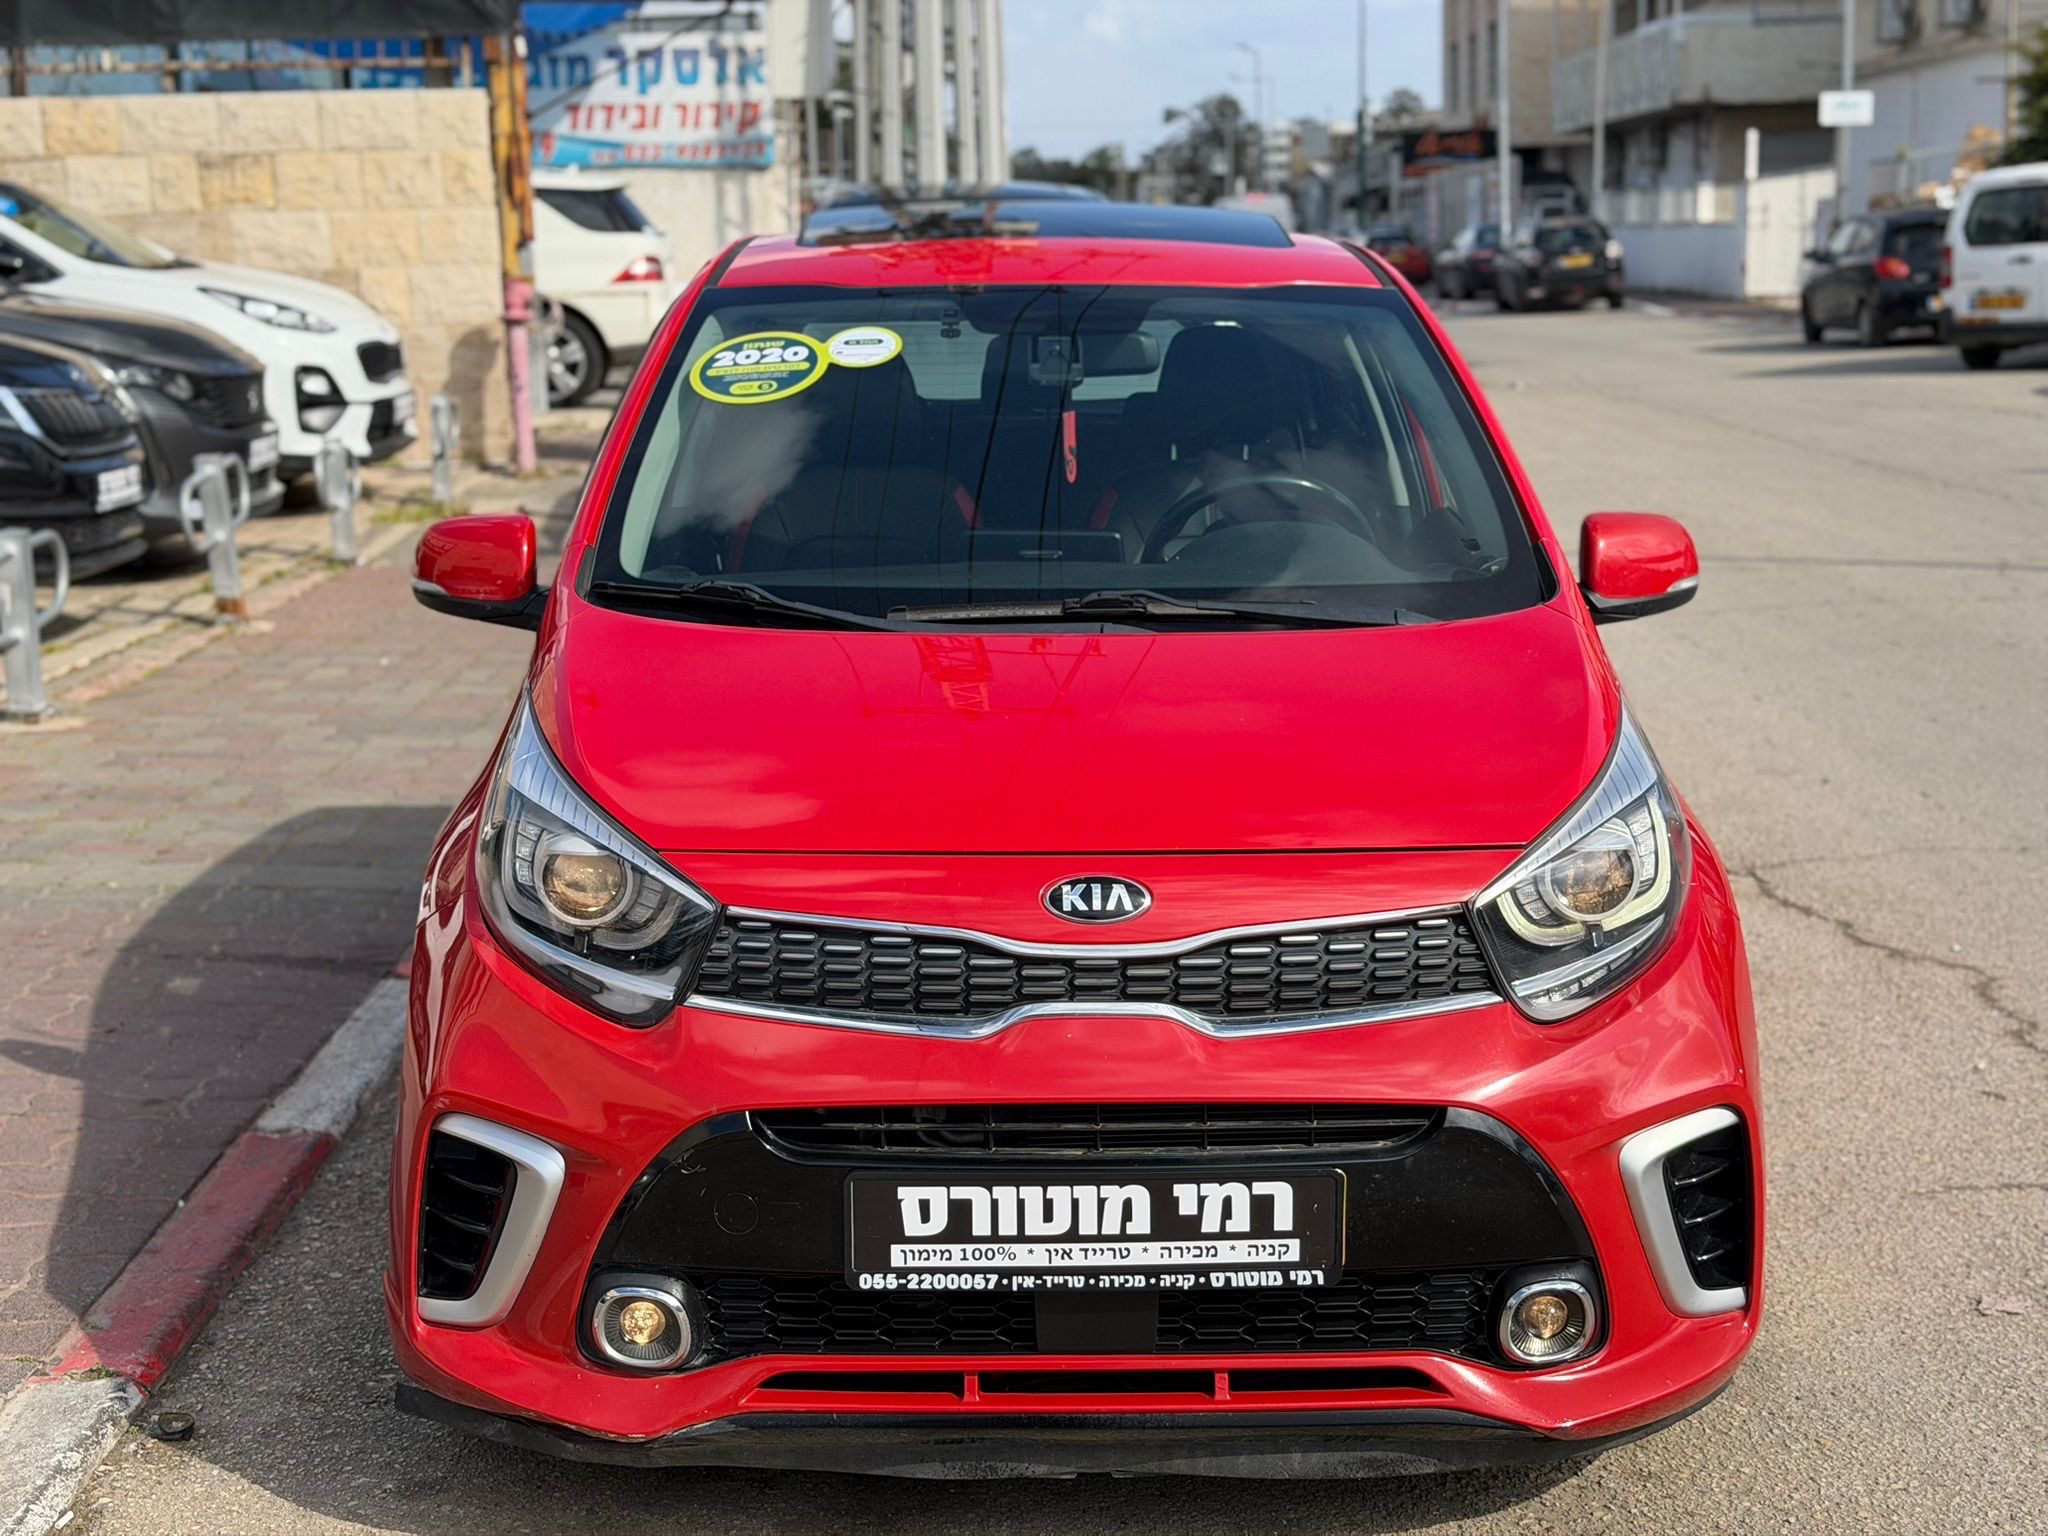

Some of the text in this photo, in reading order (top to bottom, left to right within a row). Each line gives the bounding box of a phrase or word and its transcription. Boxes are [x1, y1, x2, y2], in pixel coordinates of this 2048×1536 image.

[566, 102, 762, 135] קירור ובידוד
[711, 345, 810, 368] 2020
[1061, 883, 1134, 912] KIA
[897, 1181, 1294, 1237] רמי מוטורס
[900, 1243, 1291, 1265] קניה מכירה טרייד אין 100% מימון
[858, 1269, 1325, 1292] רמי מוטורס קניה מכירה טרייד-אין 055-2200057
